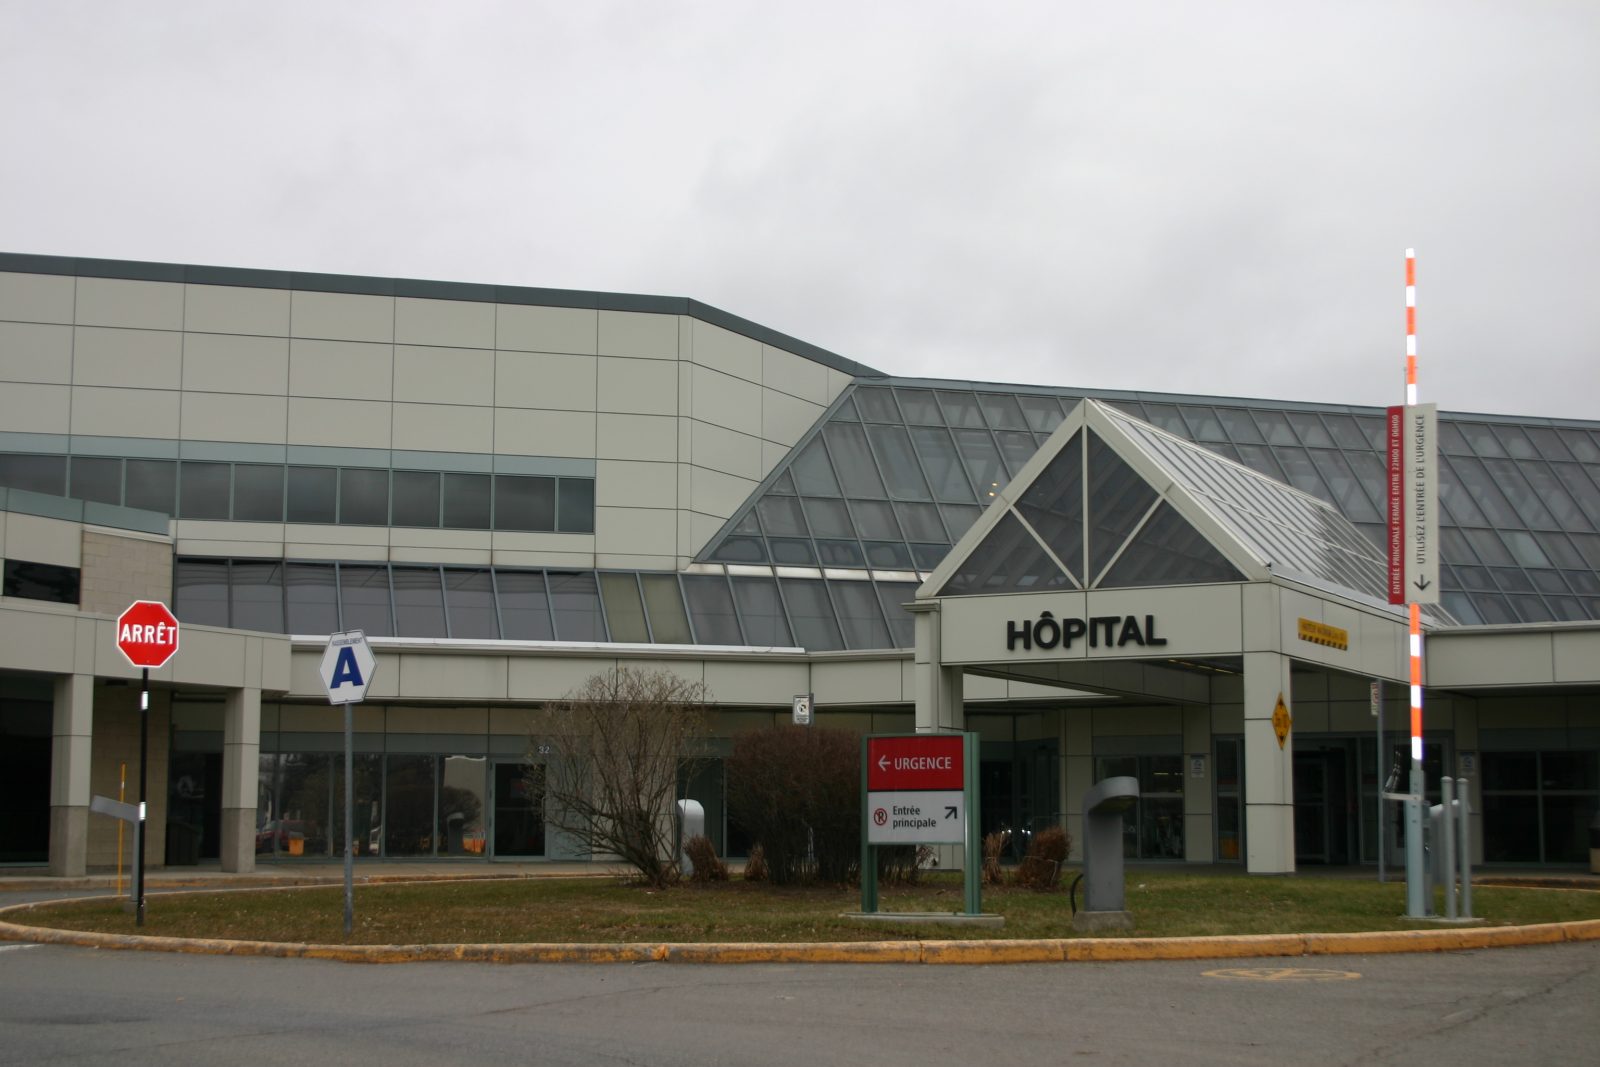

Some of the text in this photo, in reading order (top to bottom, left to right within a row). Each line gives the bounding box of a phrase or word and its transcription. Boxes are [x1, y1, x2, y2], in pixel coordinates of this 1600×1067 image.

[1391, 439, 1400, 447] ET
[1391, 473, 1400, 495] ENTRE
[1414, 414, 1425, 564] UTILISEZ L'ENTRÉE DE L'URGENCE
[1391, 496, 1400, 524] FERMÉE
[1392, 525, 1400, 566] PRINCIPALE
[1391, 568, 1400, 594] ENTRÉE
[120, 621, 176, 646] ARRÊT
[1007, 611, 1167, 650] HÔPITAL
[330, 646, 364, 689] A
[538, 745, 550, 754] 32
[894, 757, 952, 770] URGENCE
[893, 805, 920, 815] Entrée
[893, 818, 936, 829] principale
